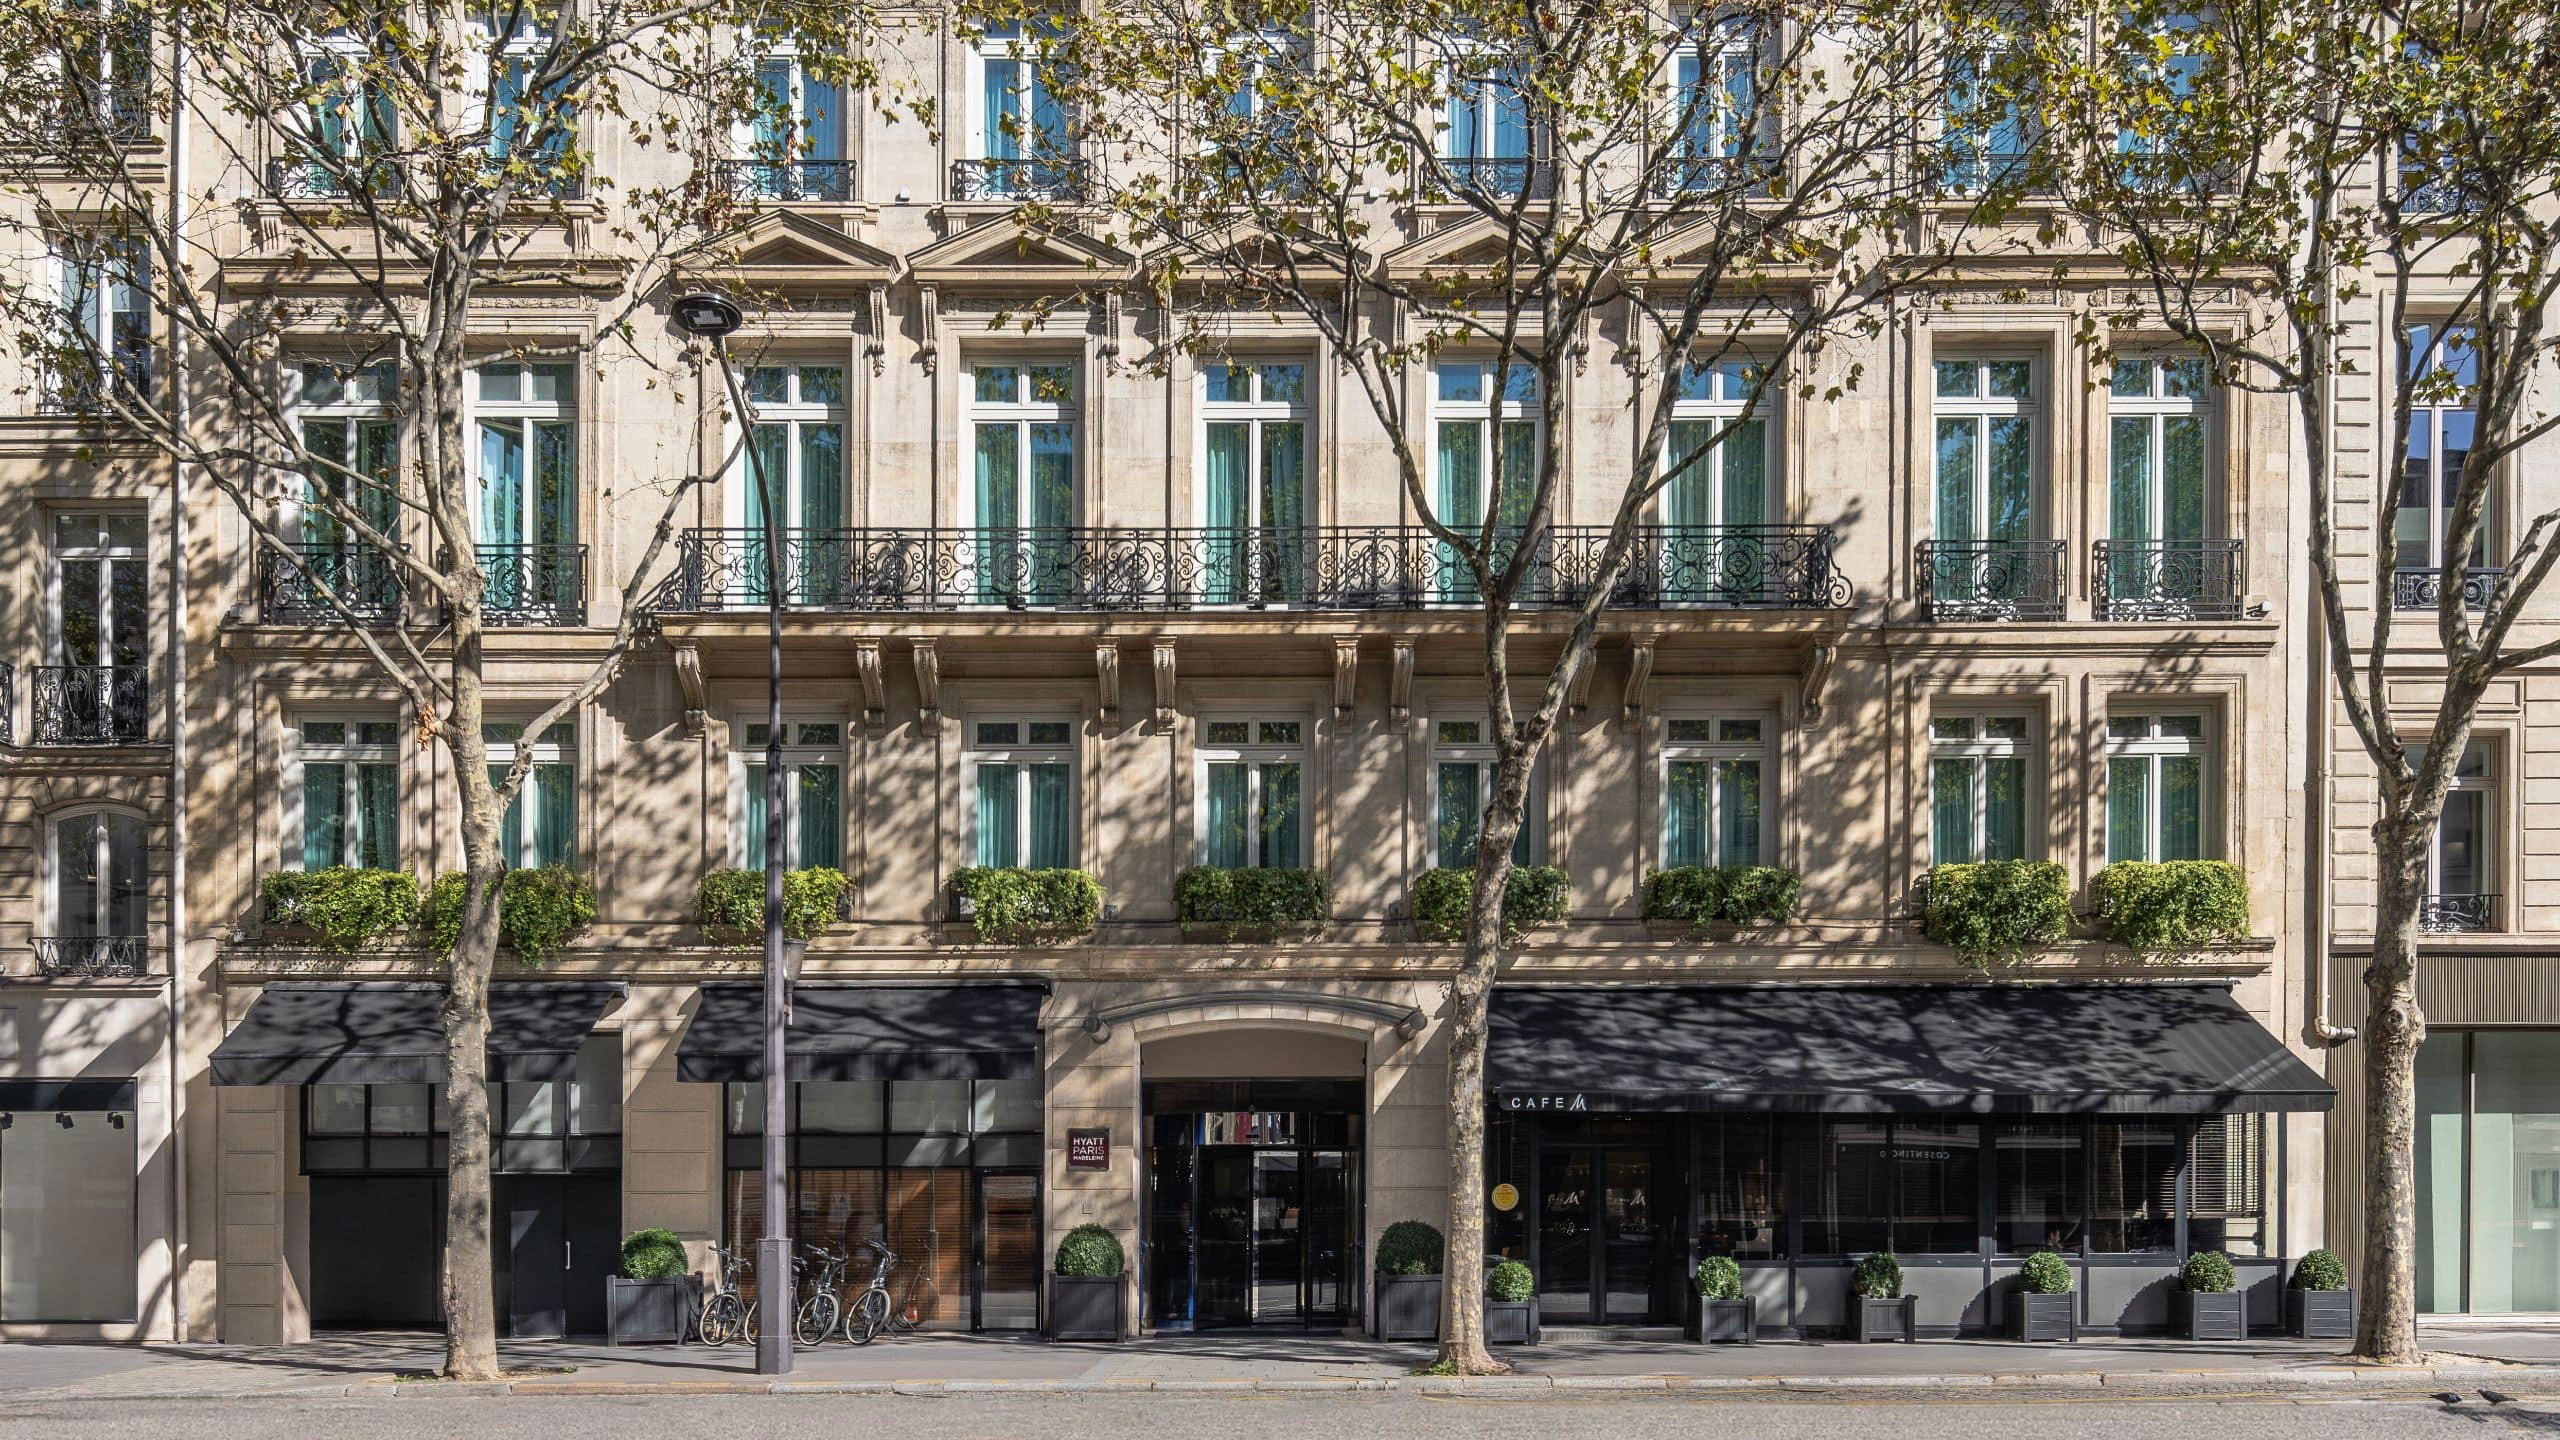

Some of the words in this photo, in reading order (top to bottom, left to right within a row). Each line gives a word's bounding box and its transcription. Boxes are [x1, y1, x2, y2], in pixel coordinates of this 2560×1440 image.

[1511, 1097, 1565, 1109] CAFE
[1073, 1137, 1104, 1146] HYATT
[1072, 1146, 1105, 1155] PARIS
